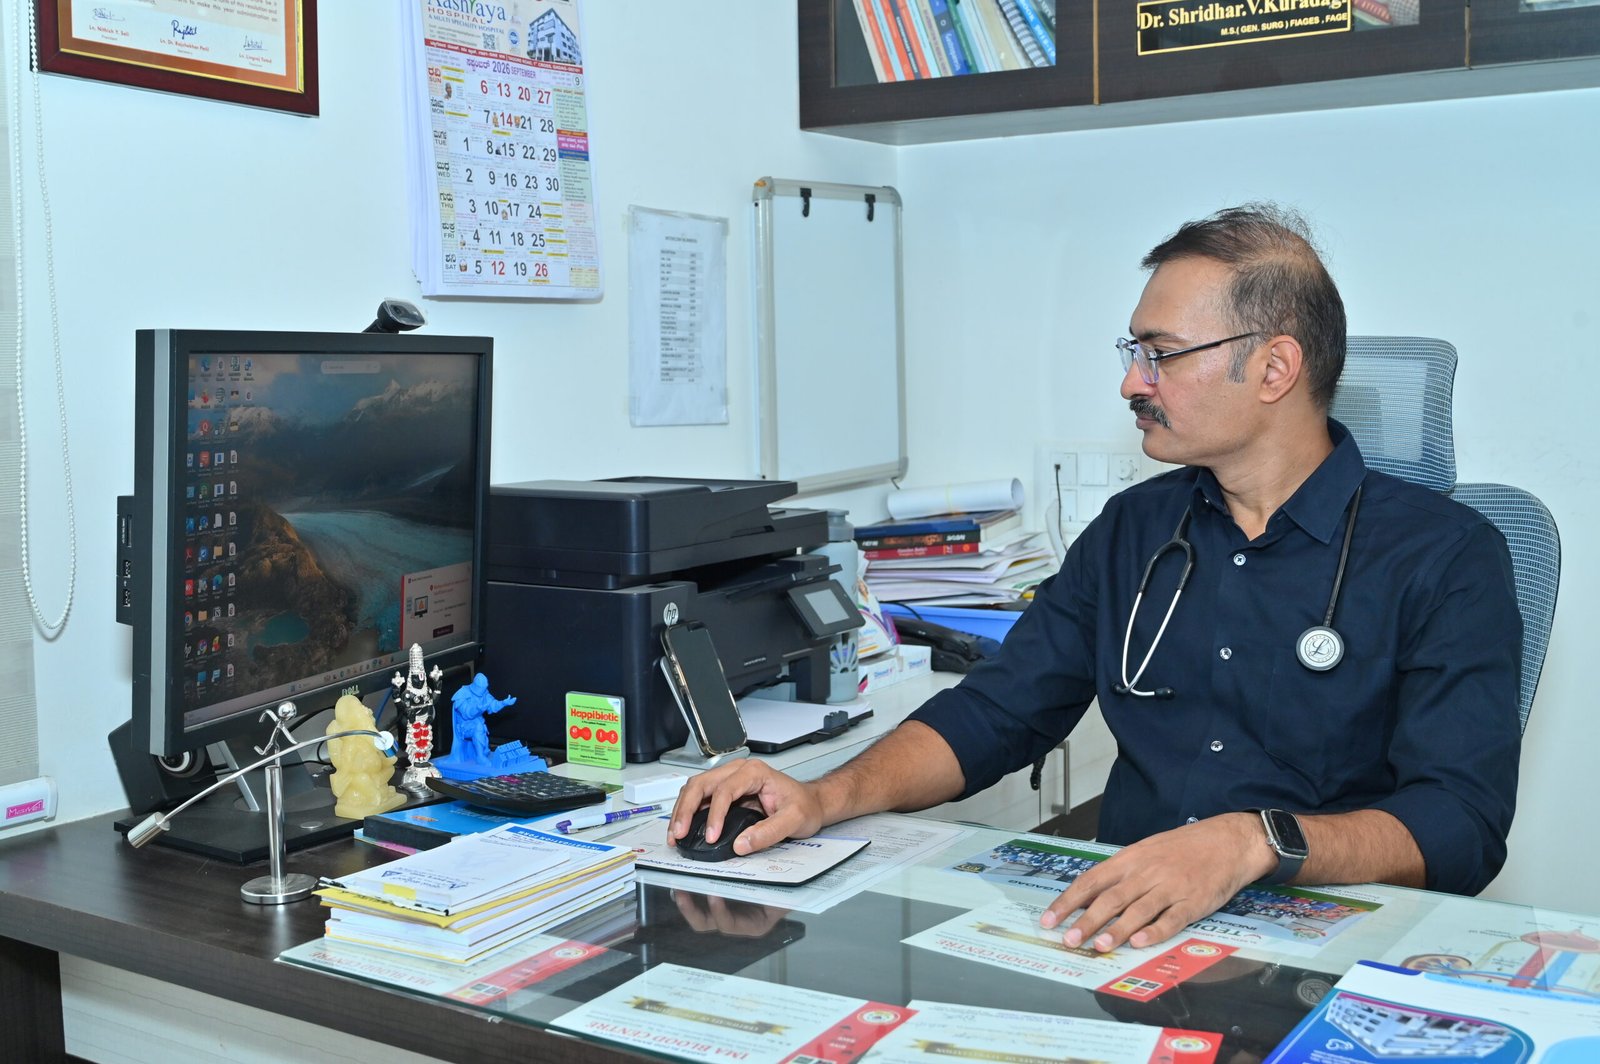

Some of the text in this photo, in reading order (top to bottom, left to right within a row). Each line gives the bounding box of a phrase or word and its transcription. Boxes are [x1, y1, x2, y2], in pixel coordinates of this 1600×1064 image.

[428, 7, 486, 25] HOSPITAL
[1139, 12, 1165, 30] Dr.
[1168, 0, 1347, 26] Shridhar.V.Kuraag
[1261, 21, 1284, 31] SURG
[1290, 16, 1320, 27] FIAGES
[492, 60, 536, 78] 2026 SEPTEMBER
[429, 76, 442, 84] SUN
[575, 76, 581, 87] 9
[480, 80, 551, 104] 6 13 20 27
[431, 107, 445, 115] MON
[483, 109, 554, 133] 7 14 21 28
[463, 137, 557, 162] 1 8 15 22 29
[465, 168, 559, 191] 2 9 16 23 30
[468, 199, 542, 218] 3 10 17 24
[473, 229, 545, 247] 4 11 18 25
[475, 260, 548, 277] 5 12 19 26
[571, 708, 619, 722] Happibiotic
[518, 830, 600, 850] INVESTIGATION FORM
[1008, 880, 1054, 890] GADAG
[1207, 918, 1257, 931] INDIAN
[936, 940, 994, 956] CENTRE
[996, 952, 1048, 969] BLOOD
[1052, 966, 1083, 977] IMA
[586, 1021, 749, 1060] IMA BLOOD CENTRE
